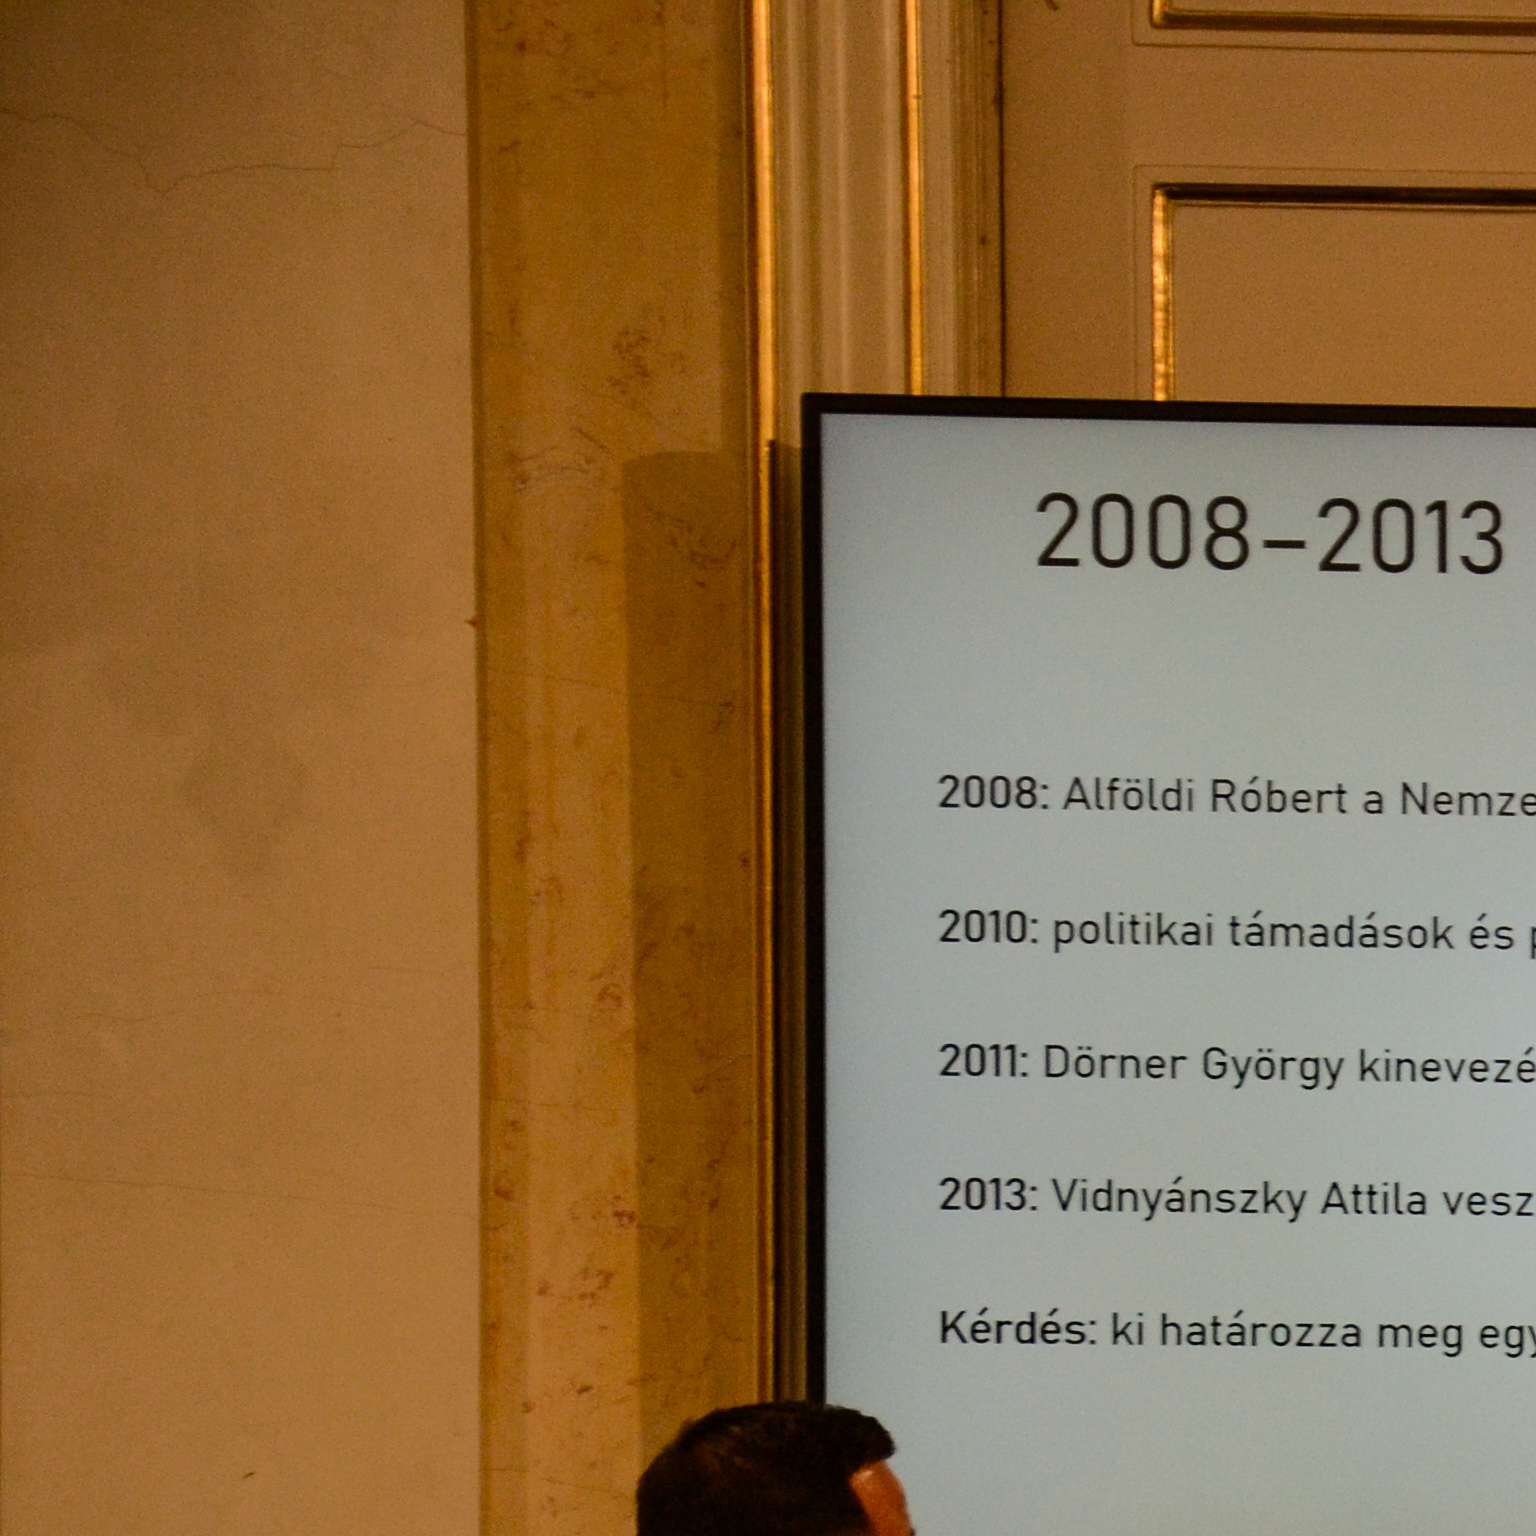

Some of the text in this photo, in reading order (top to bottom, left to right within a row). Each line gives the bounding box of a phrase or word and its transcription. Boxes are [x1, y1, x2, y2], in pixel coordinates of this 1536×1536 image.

[938, 773, 1050, 810] 2008:
[1062, 776, 1194, 812] Alföldi
[1210, 775, 1348, 815] Róbert
[1362, 789, 1385, 815] a
[938, 908, 1039, 945] 2010:
[1053, 911, 1214, 954] politikai
[1228, 909, 1455, 950] támadások
[1468, 912, 1515, 951] és
[939, 1042, 1029, 1078] 2011:
[1044, 1043, 1189, 1080] Dörner
[1202, 1045, 1345, 1091] György
[938, 1176, 1038, 1212] 2013:
[1050, 1175, 1308, 1224] Vidnyánszky
[1320, 1180, 1428, 1216] Attila
[939, 1306, 1097, 1346] Kérdés:
[1111, 1311, 1145, 1346] ki
[1160, 1308, 1363, 1348] határozza
[1377, 1323, 1464, 1359] meg
